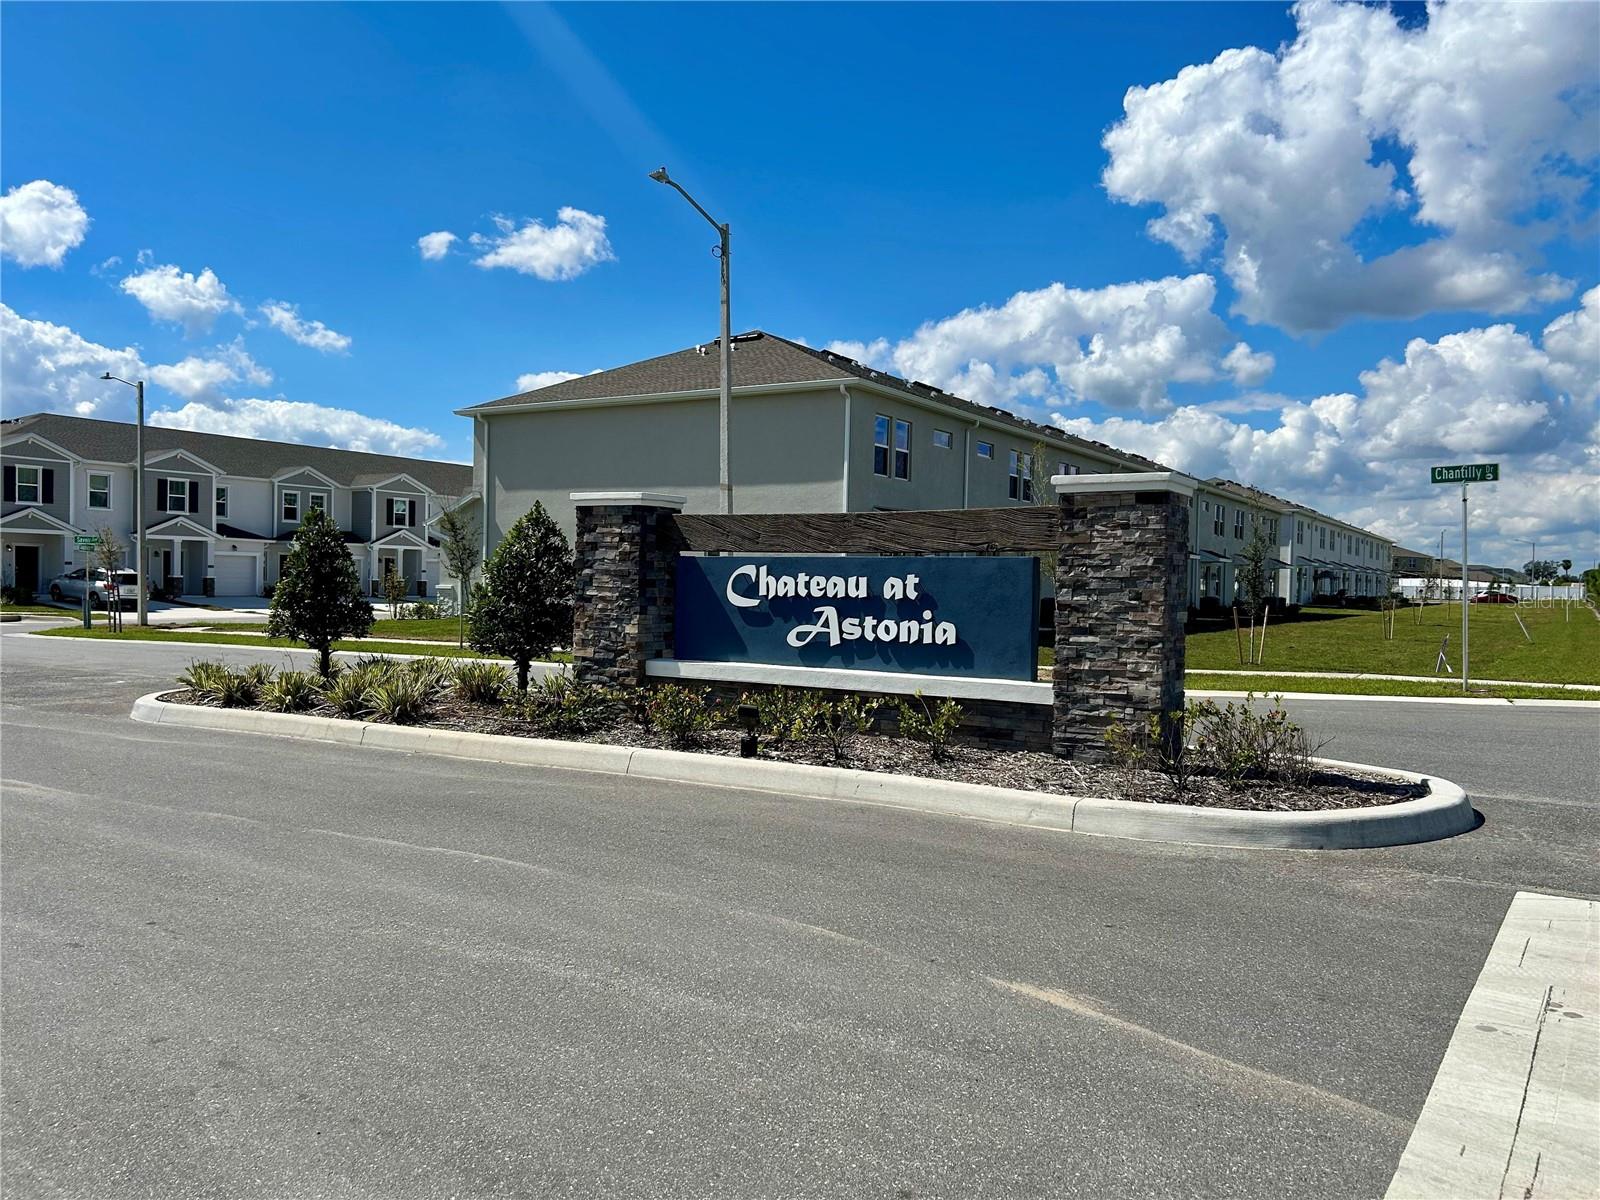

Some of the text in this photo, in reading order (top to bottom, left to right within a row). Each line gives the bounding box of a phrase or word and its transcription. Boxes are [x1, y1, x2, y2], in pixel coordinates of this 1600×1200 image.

[1435, 464, 1494, 481] Chantilly Dr
[726, 564, 920, 608] Chateau at
[786, 605, 957, 648] Astonia
